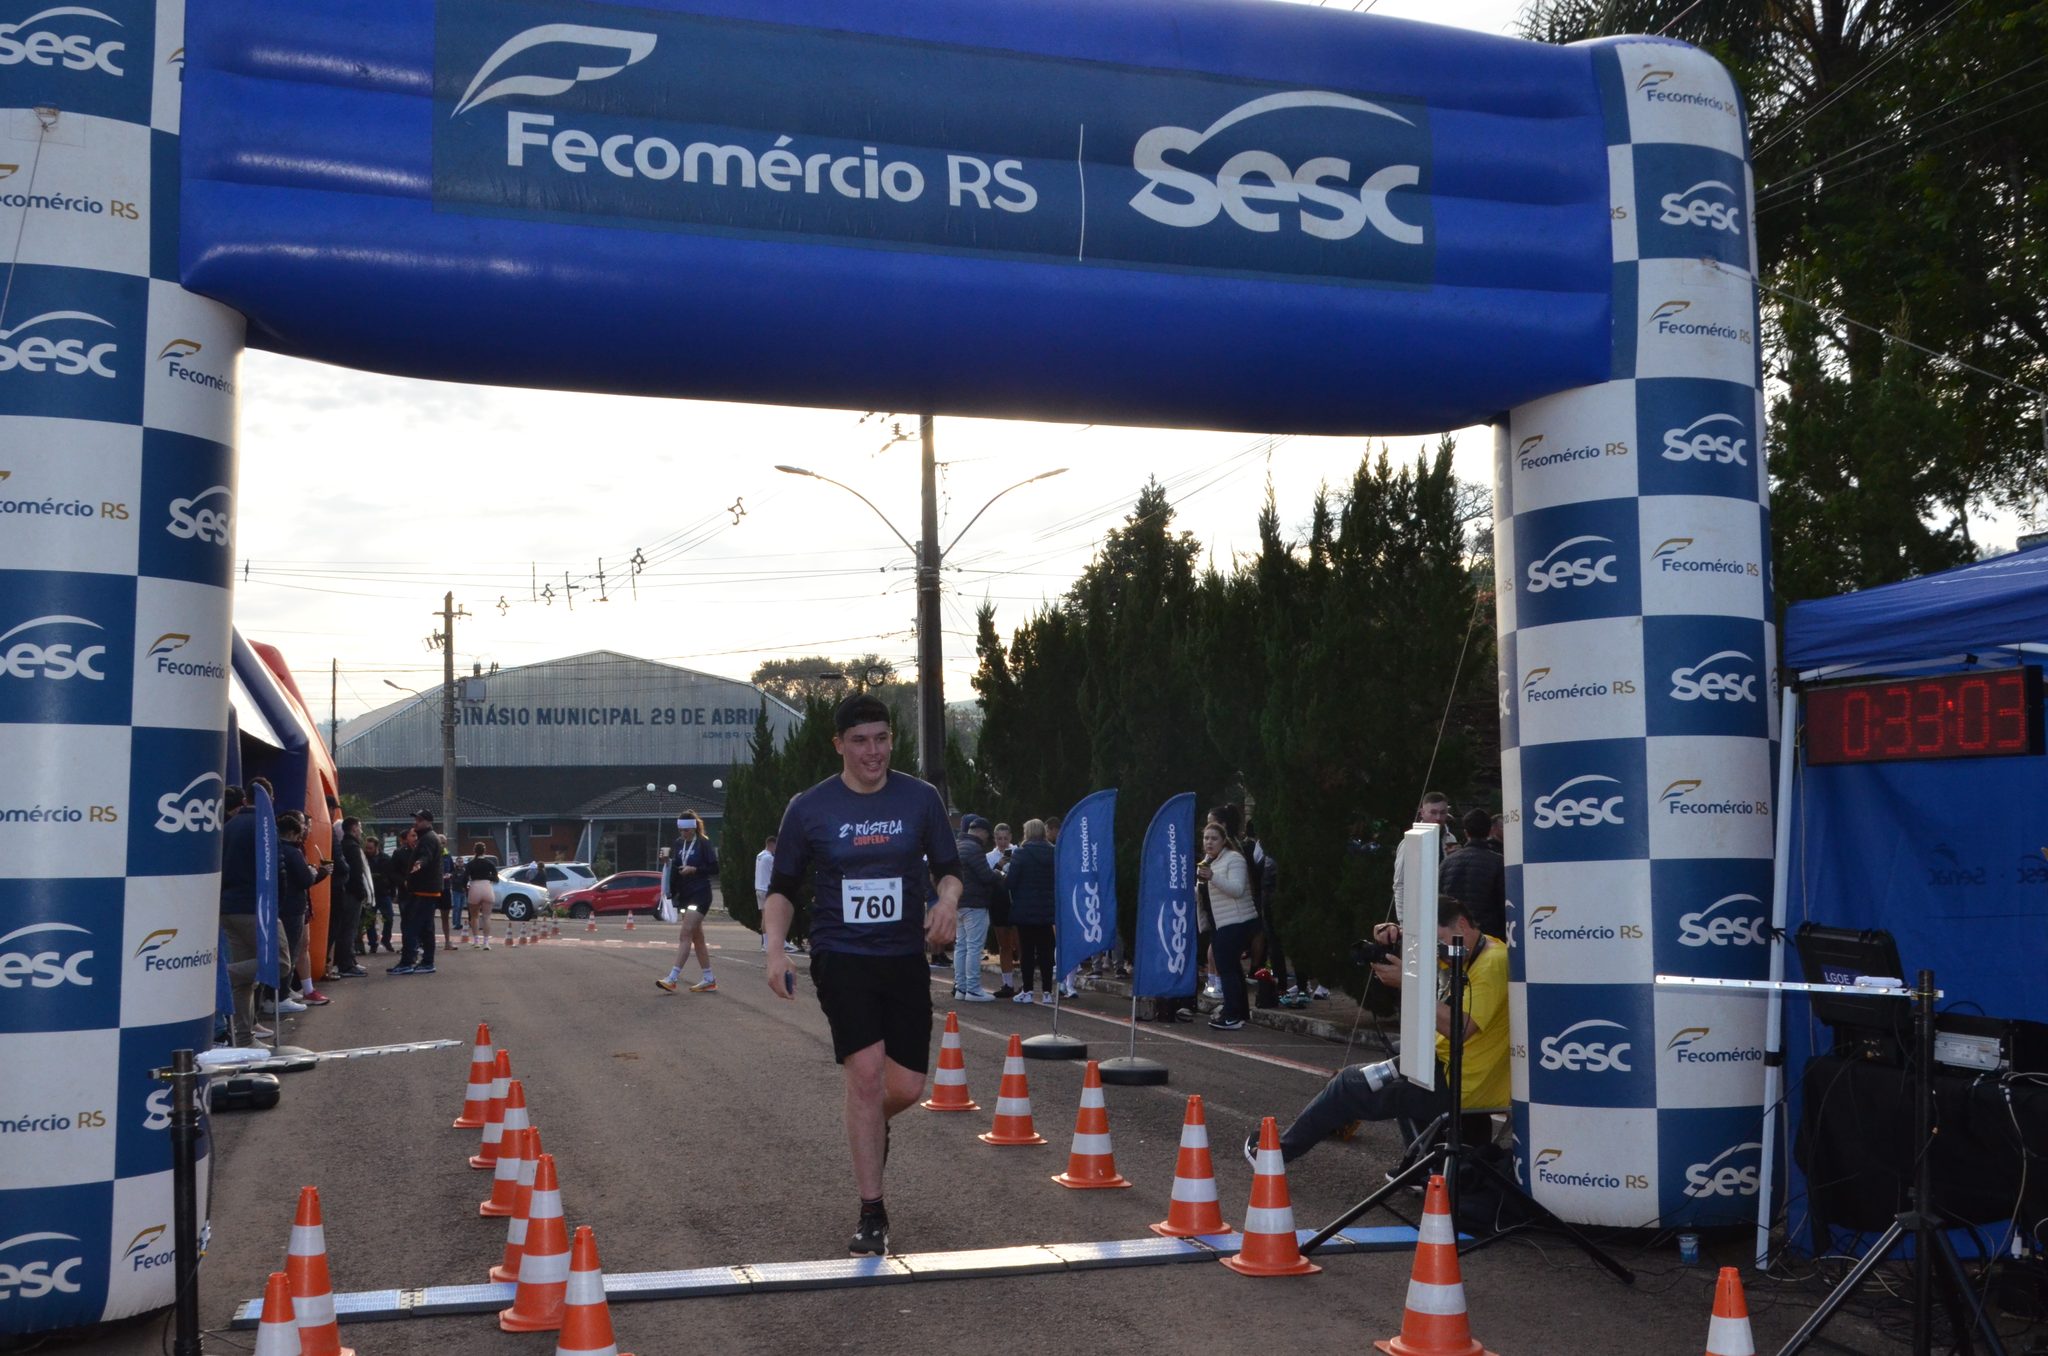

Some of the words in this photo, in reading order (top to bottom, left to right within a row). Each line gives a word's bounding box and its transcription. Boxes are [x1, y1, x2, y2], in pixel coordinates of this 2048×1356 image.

[1646, 89, 1723, 111] Fecomércio
[507, 111, 925, 203] Fecomércio
[948, 154, 1039, 214] RS
[1128, 126, 1424, 245] Sesc
[0, 191, 103, 214] comércio
[110, 199, 139, 220] RS
[1660, 192, 1740, 235] Sesc
[1658, 320, 1737, 341] Fecomércio
[1739, 329, 1751, 345] RS
[168, 361, 236, 395] Fecomérc
[1520, 446, 1600, 471] Fecomércio
[1605, 441, 1628, 457] RS
[1661, 428, 1747, 467] Sesc
[0, 498, 94, 517] omércio
[101, 503, 130, 521] RS
[1527, 555, 1617, 593] Sesc
[1662, 557, 1744, 575] Fecomércio
[1746, 563, 1759, 577] RS
[0, 643, 105, 680] esc
[157, 657, 226, 679] Fecomércio
[1527, 682, 1607, 702] Fecomércio
[1612, 680, 1636, 695] RS
[1669, 667, 1756, 703] Sesc
[536, 707, 644, 726] MUNICIPAL
[650, 707, 676, 726] 29
[681, 707, 706, 726] DE
[1842, 675, 2027, 757] 0:33:03
[0, 804, 82, 822] mércio
[89, 806, 117, 823] RS
[1533, 794, 1625, 829] Sesc
[1669, 799, 1753, 816] Fecomércio
[1755, 801, 1769, 816] RS
[1080, 816, 1090, 873] Fecomércio
[1168, 823, 1178, 889] Fecomércio
[850, 894, 895, 920] 760
[1084, 881, 1102, 944] Sesc
[1168, 900, 1187, 975] Sesc
[1534, 923, 1614, 940] Fecomércio
[1620, 925, 1643, 939] RS
[1677, 912, 1766, 947] Sesc
[0, 950, 93, 988] esc
[145, 949, 213, 972] Fecomércio
[1540, 1036, 1631, 1072] Sesc
[1677, 1047, 1762, 1063] Fecomércio
[0, 1113, 70, 1132] mércio
[78, 1110, 106, 1128] RS
[1539, 1166, 1620, 1188] Fecomércio
[1625, 1175, 1649, 1189] RS
[1683, 1163, 1760, 1198] Ses
[0, 1256, 81, 1299] esc
